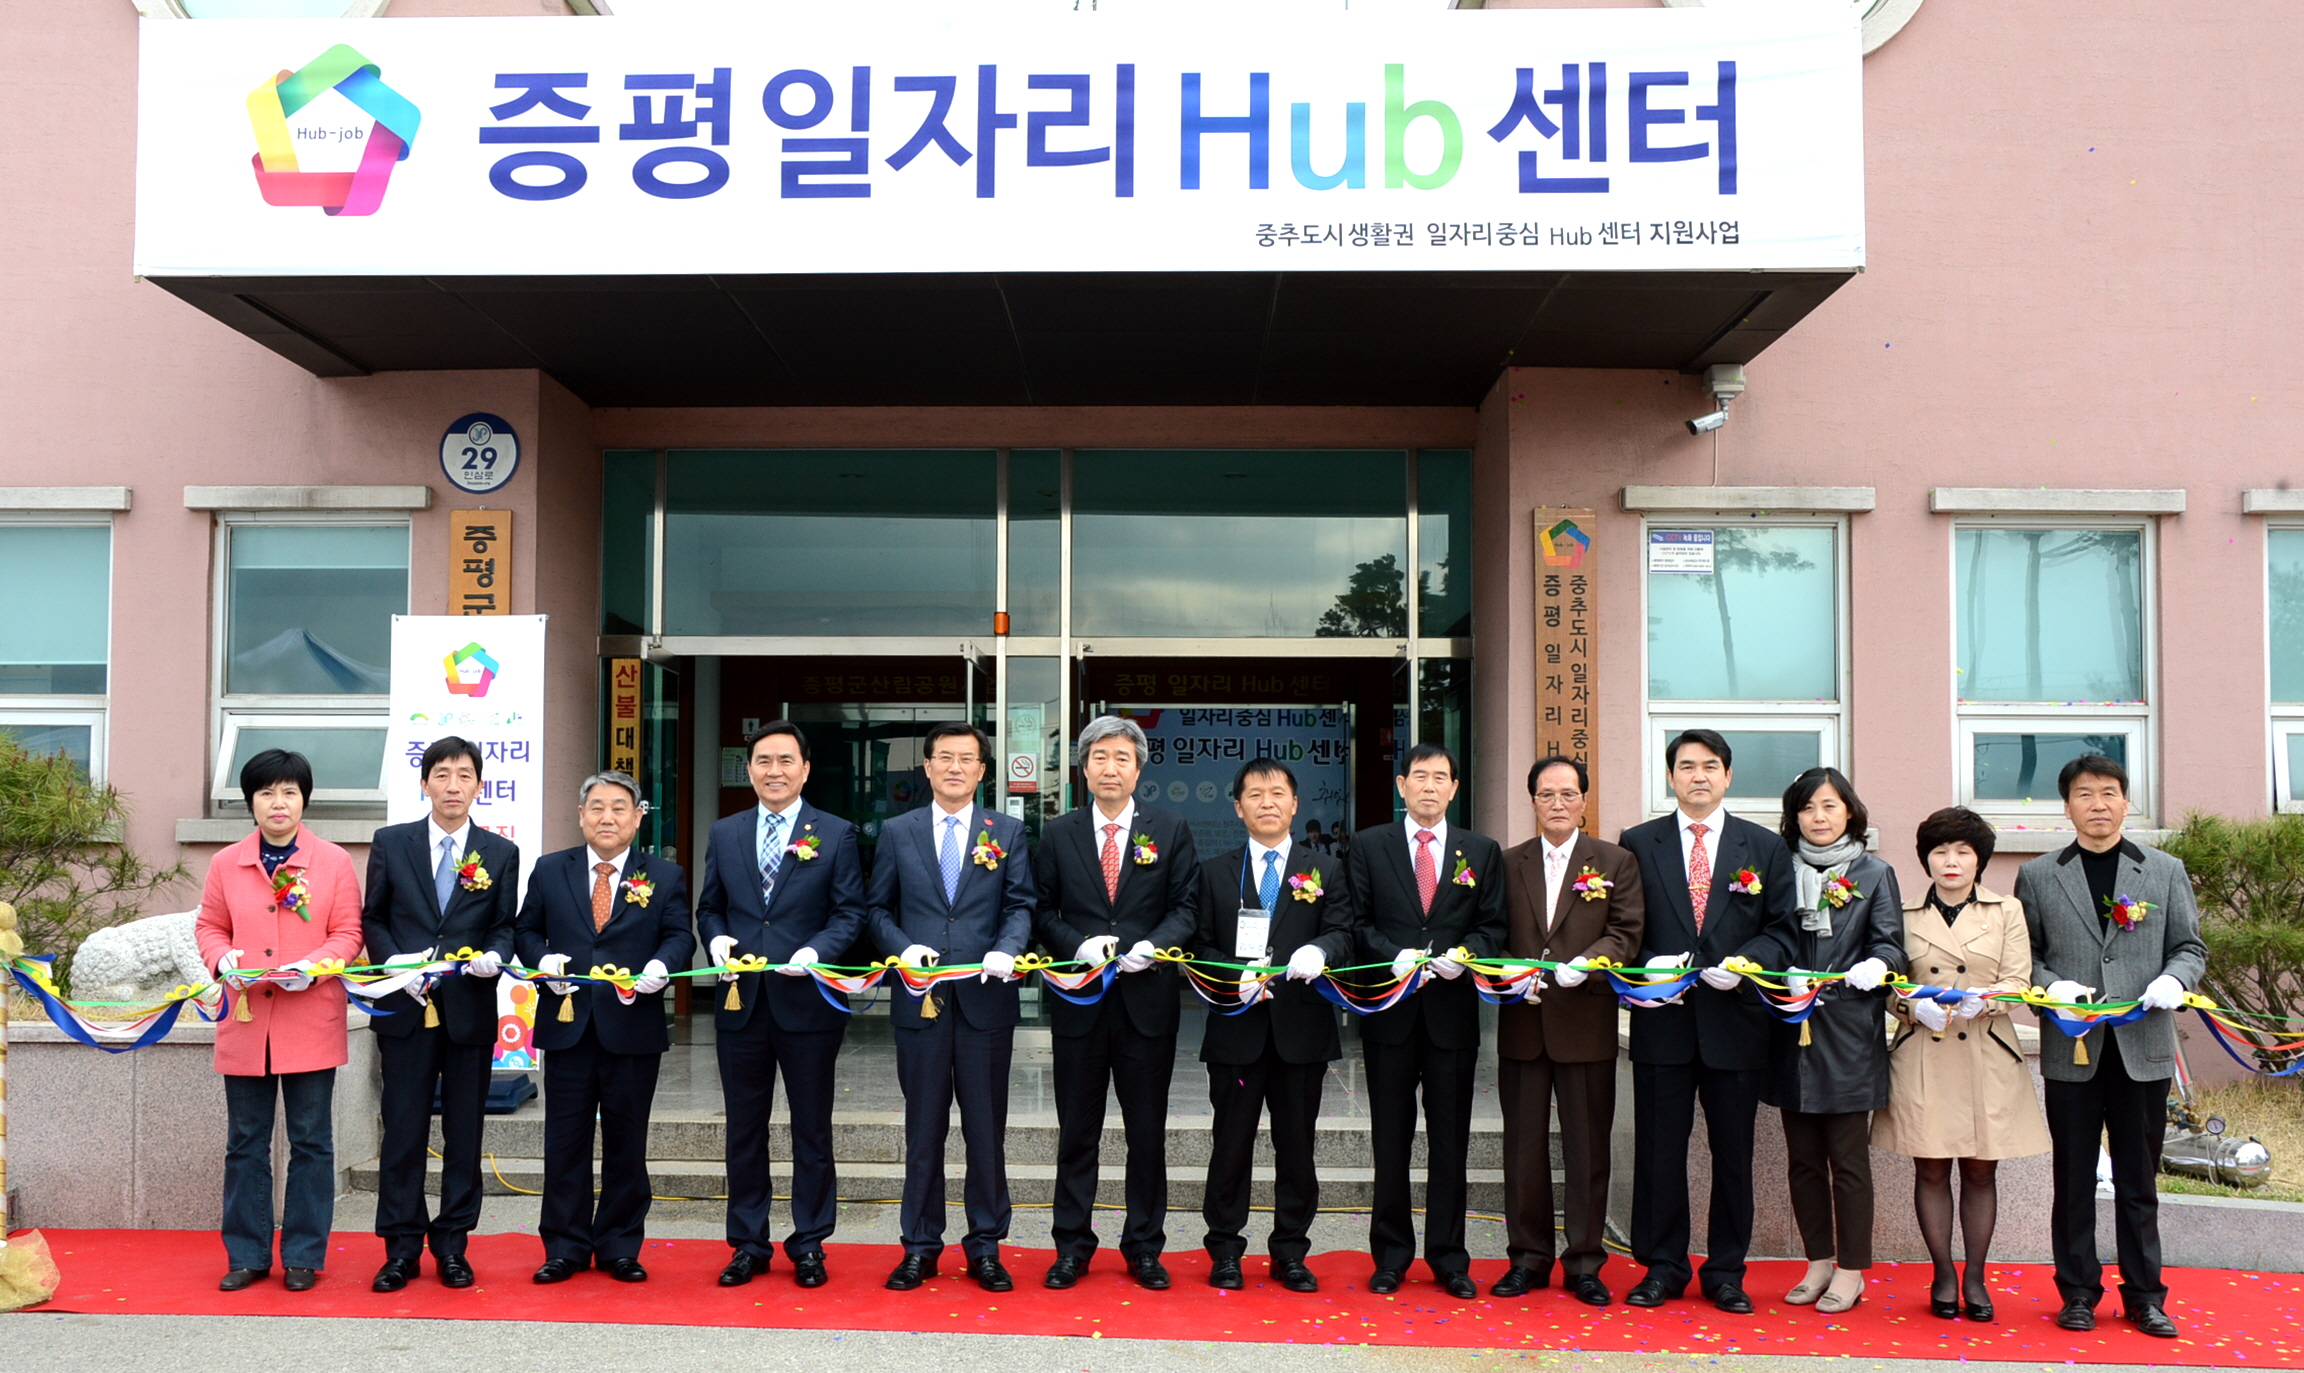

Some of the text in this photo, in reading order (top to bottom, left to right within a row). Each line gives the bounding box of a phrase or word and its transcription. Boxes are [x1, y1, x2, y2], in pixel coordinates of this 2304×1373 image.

[297, 126, 364, 143] Hub-job
[1181, 64, 1463, 191] Hub
[1487, 61, 1737, 195] 센터
[1550, 226, 1592, 246] Hub
[1598, 221, 1641, 246] 센터
[1649, 220, 1739, 245] 지원사업
[461, 446, 498, 470] 29
[464, 471, 494, 480] 인삼로
[1666, 533, 1683, 541] CCTV
[1114, 674, 1331, 696] 증평 일자리 Hub 센터
[1277, 709, 1317, 728] Hub
[1173, 738, 1245, 765] 일자리
[1256, 738, 1304, 761] Hub
